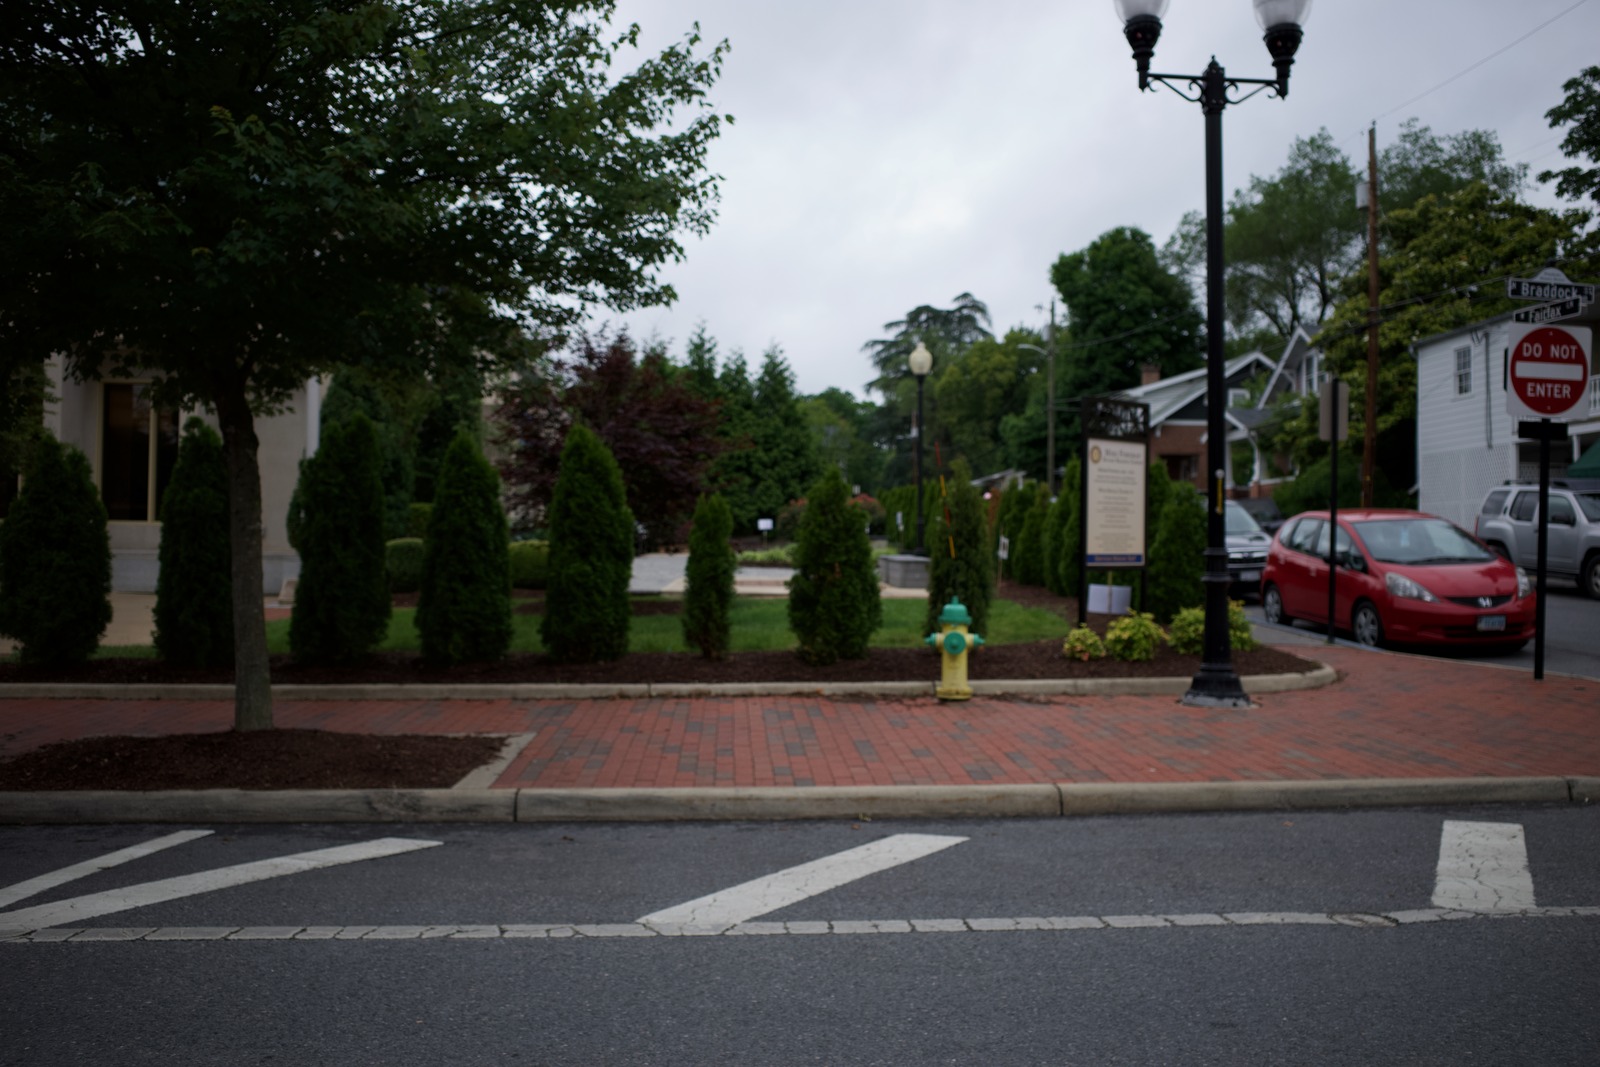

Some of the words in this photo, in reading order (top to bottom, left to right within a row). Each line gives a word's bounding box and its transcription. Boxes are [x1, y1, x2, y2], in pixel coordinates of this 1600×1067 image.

[1521, 282, 1578, 300] Braddock
[1529, 305, 1562, 324] Fairfax
[1522, 342, 1543, 358] DO
[1550, 344, 1578, 359] NOT
[1527, 382, 1571, 399] ENTER
